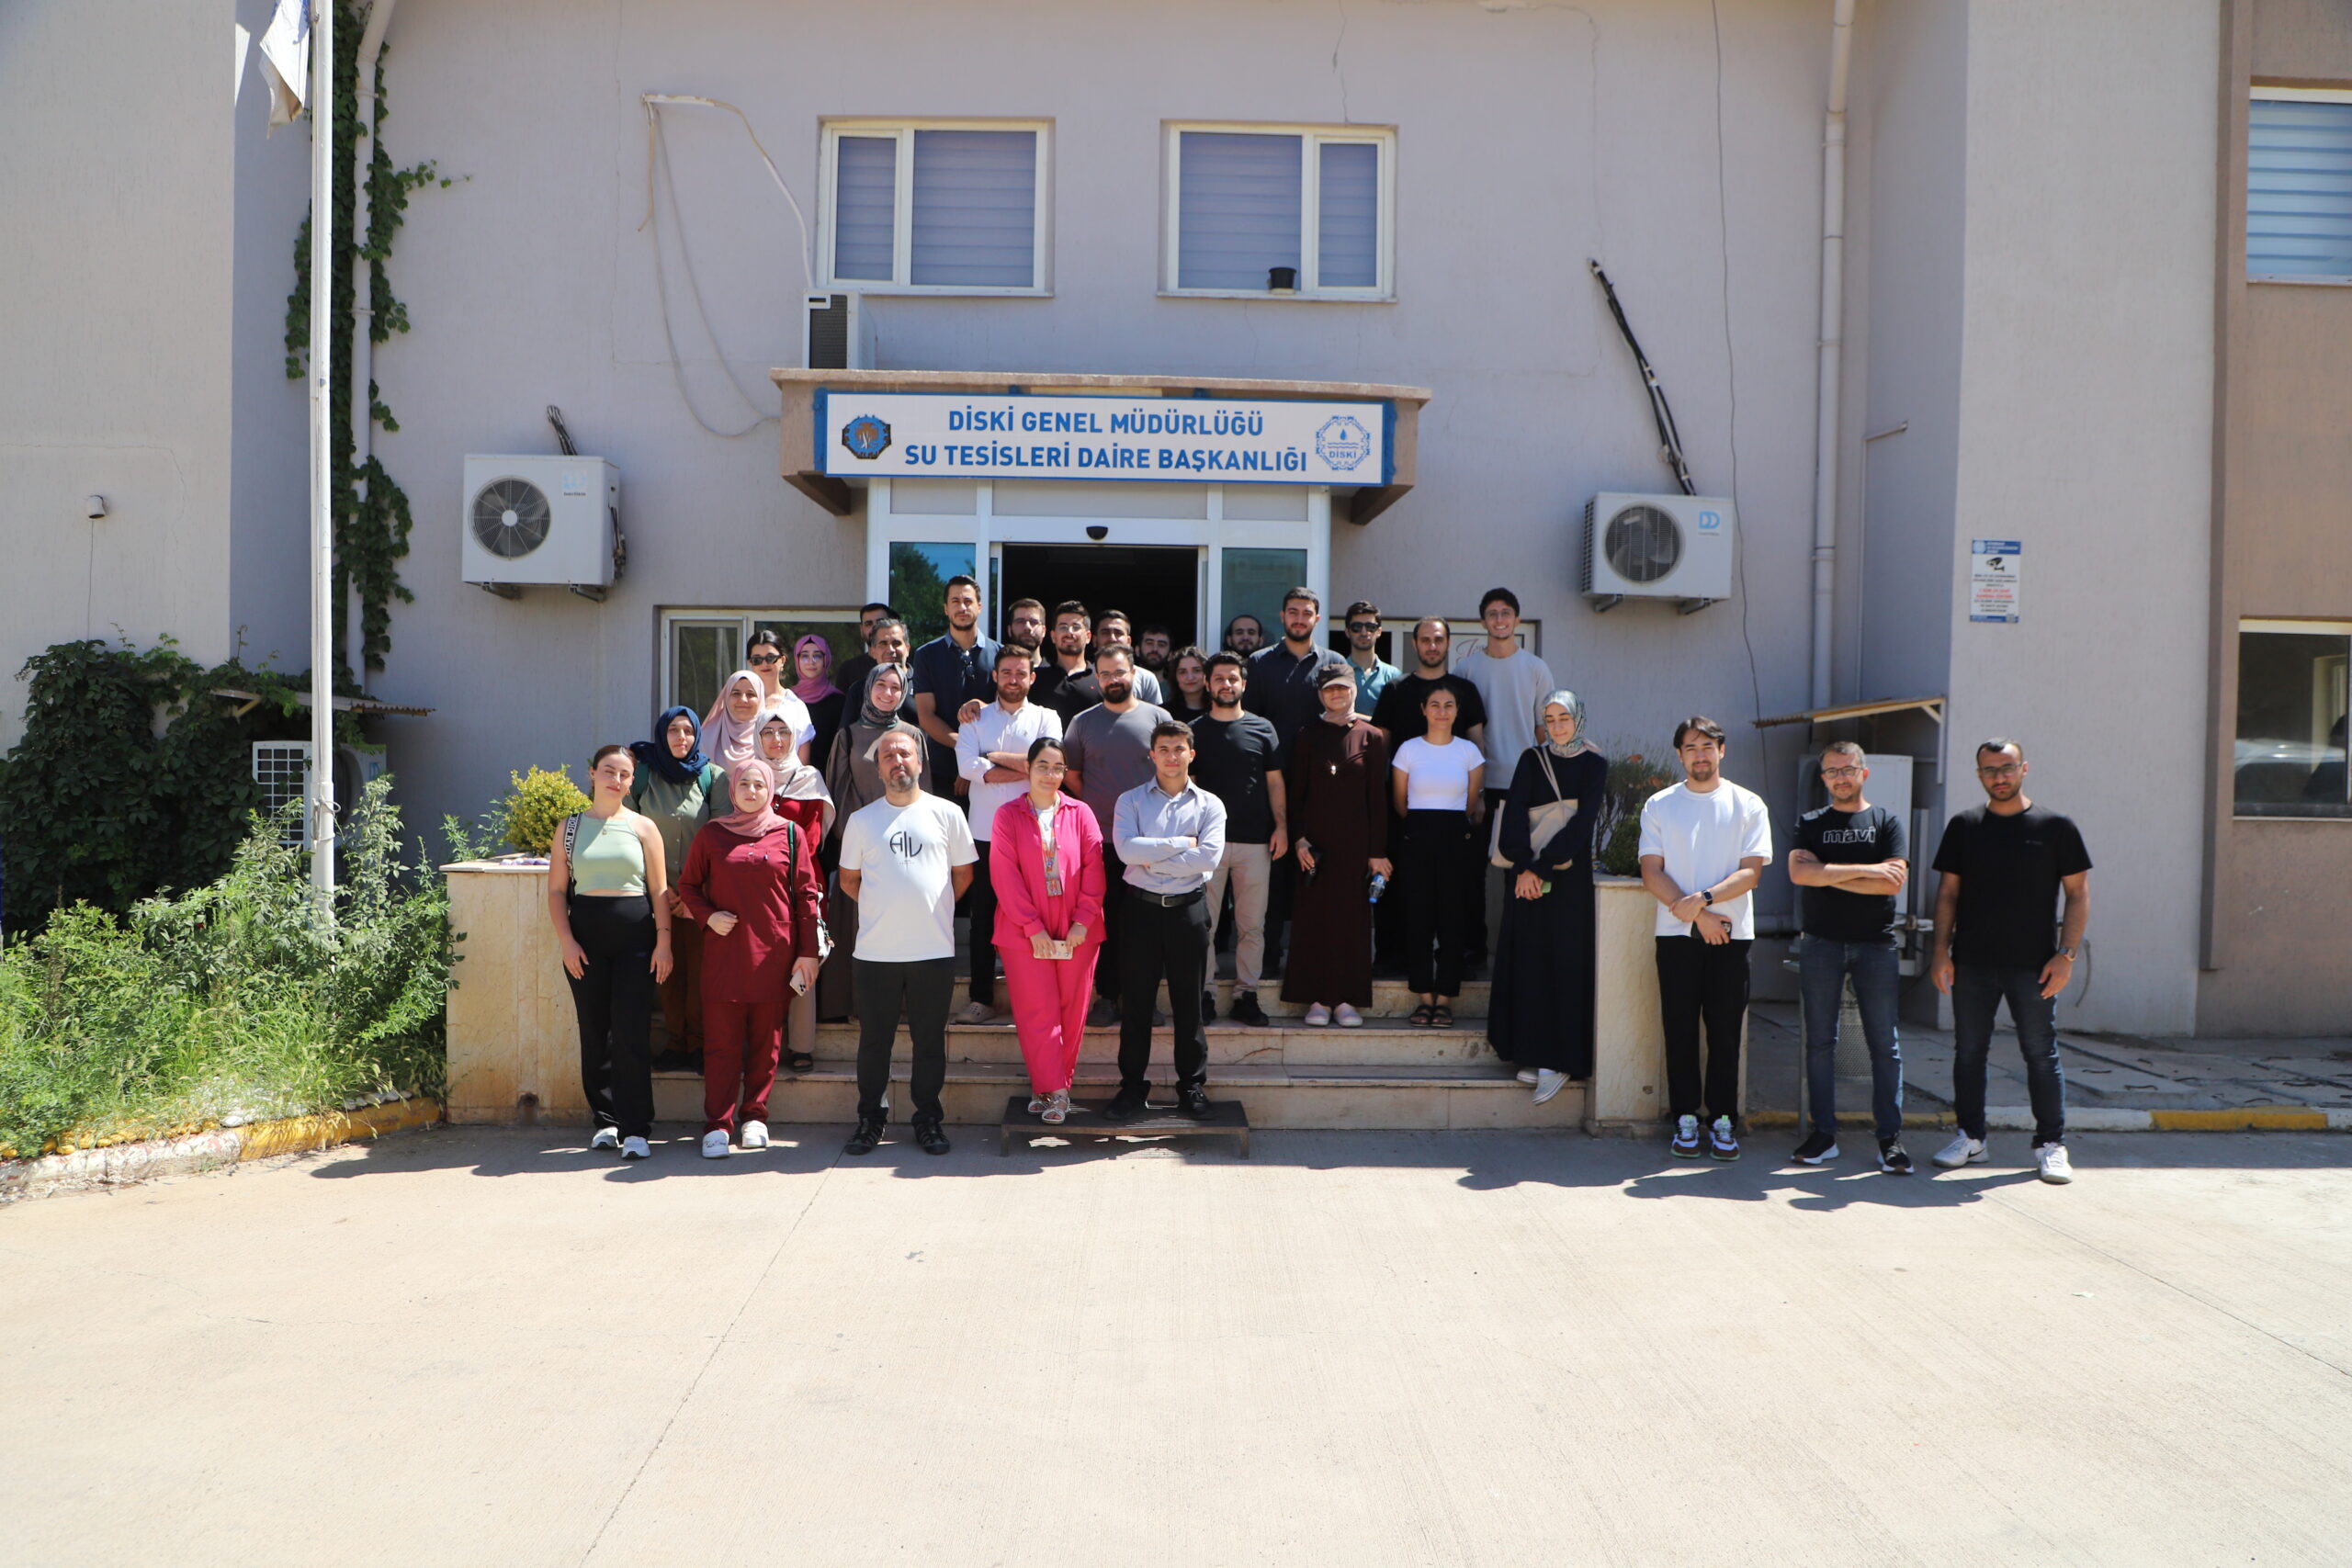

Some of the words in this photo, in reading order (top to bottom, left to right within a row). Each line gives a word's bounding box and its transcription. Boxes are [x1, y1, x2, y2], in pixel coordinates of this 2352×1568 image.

[949, 405, 1013, 431] DİSKİ
[1022, 412, 1102, 433] GENEL
[1111, 408, 1263, 435] MÜDÜRLÜĞÜ
[905, 445, 936, 465] SU
[944, 440, 1069, 467] TESİSLERİ
[1078, 443, 1149, 468] DAİRE
[1159, 446, 1306, 471] BAŞKANLIĞI
[1823, 826, 1876, 843] mavi
